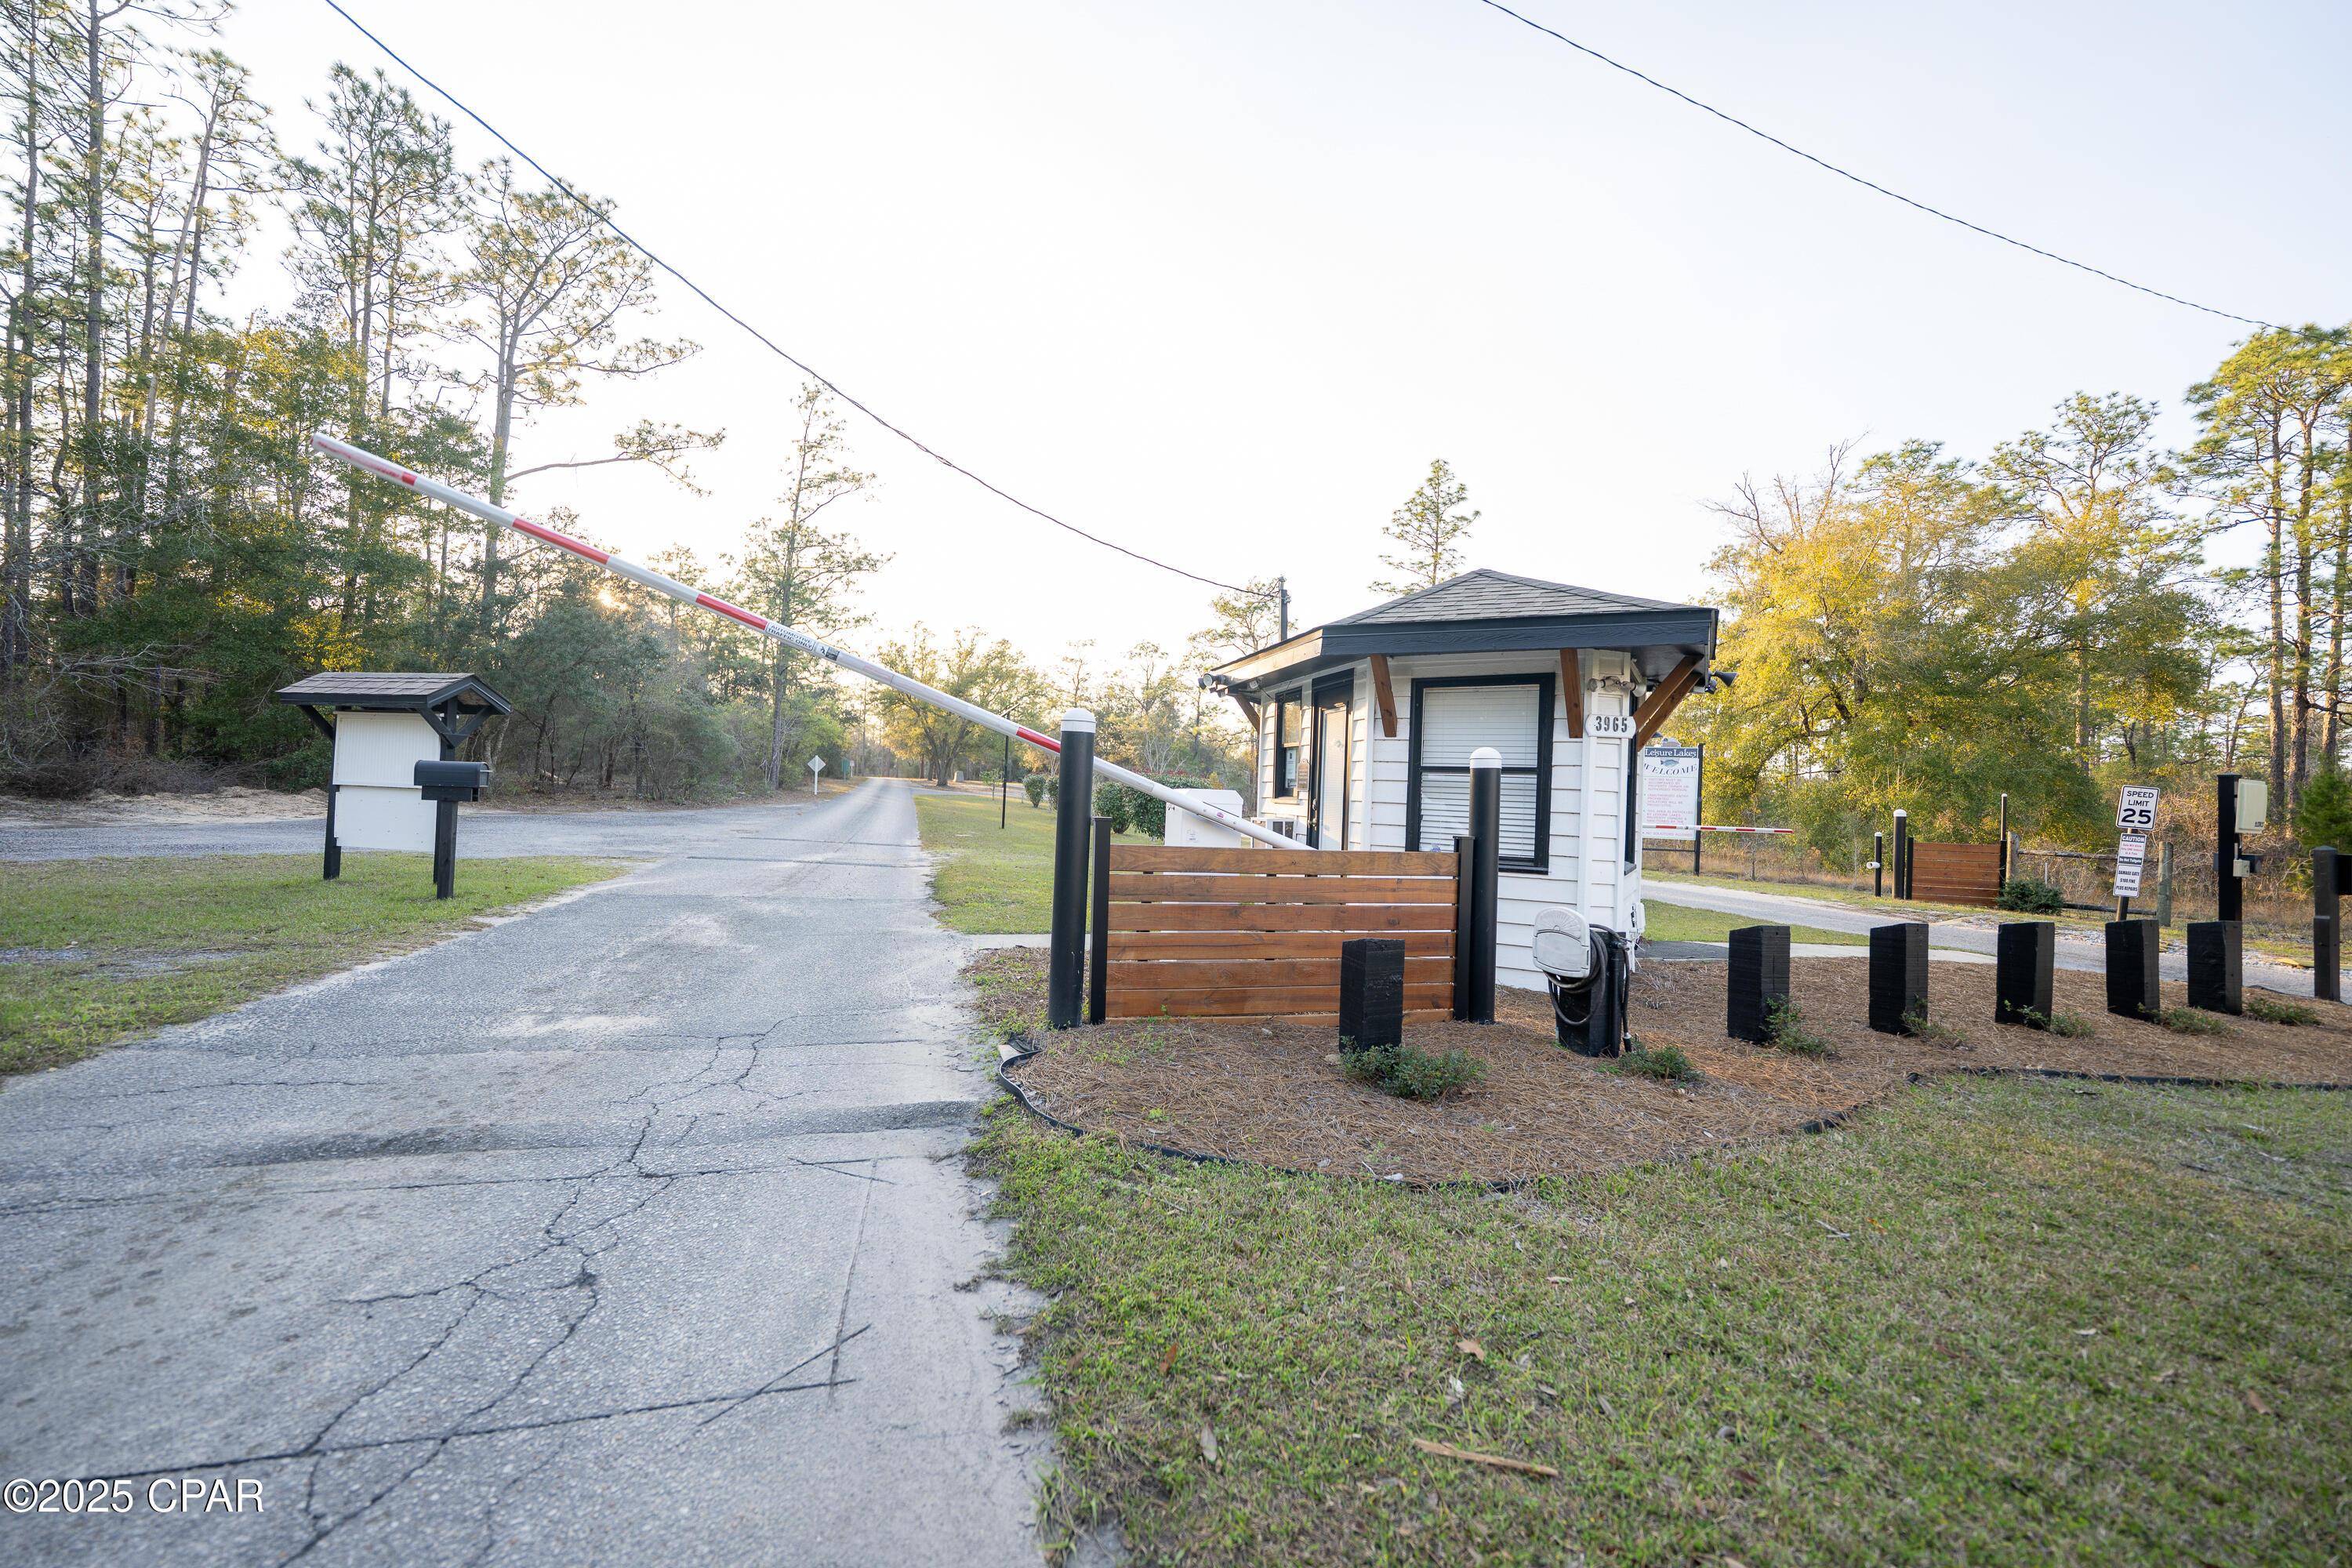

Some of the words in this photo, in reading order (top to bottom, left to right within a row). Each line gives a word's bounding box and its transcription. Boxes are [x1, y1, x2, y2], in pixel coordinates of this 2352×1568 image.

[768, 628, 794, 642] TRAFFIC
[795, 639, 812, 648] ONLY
[771, 625, 811, 644] AUTOMOTIVE
[1595, 716, 1628, 732] 3965
[1645, 749, 1673, 757] Leisure
[1674, 749, 1697, 758] Lakes
[1643, 763, 1697, 775] WELCOME
[2121, 808, 2151, 825] 25
